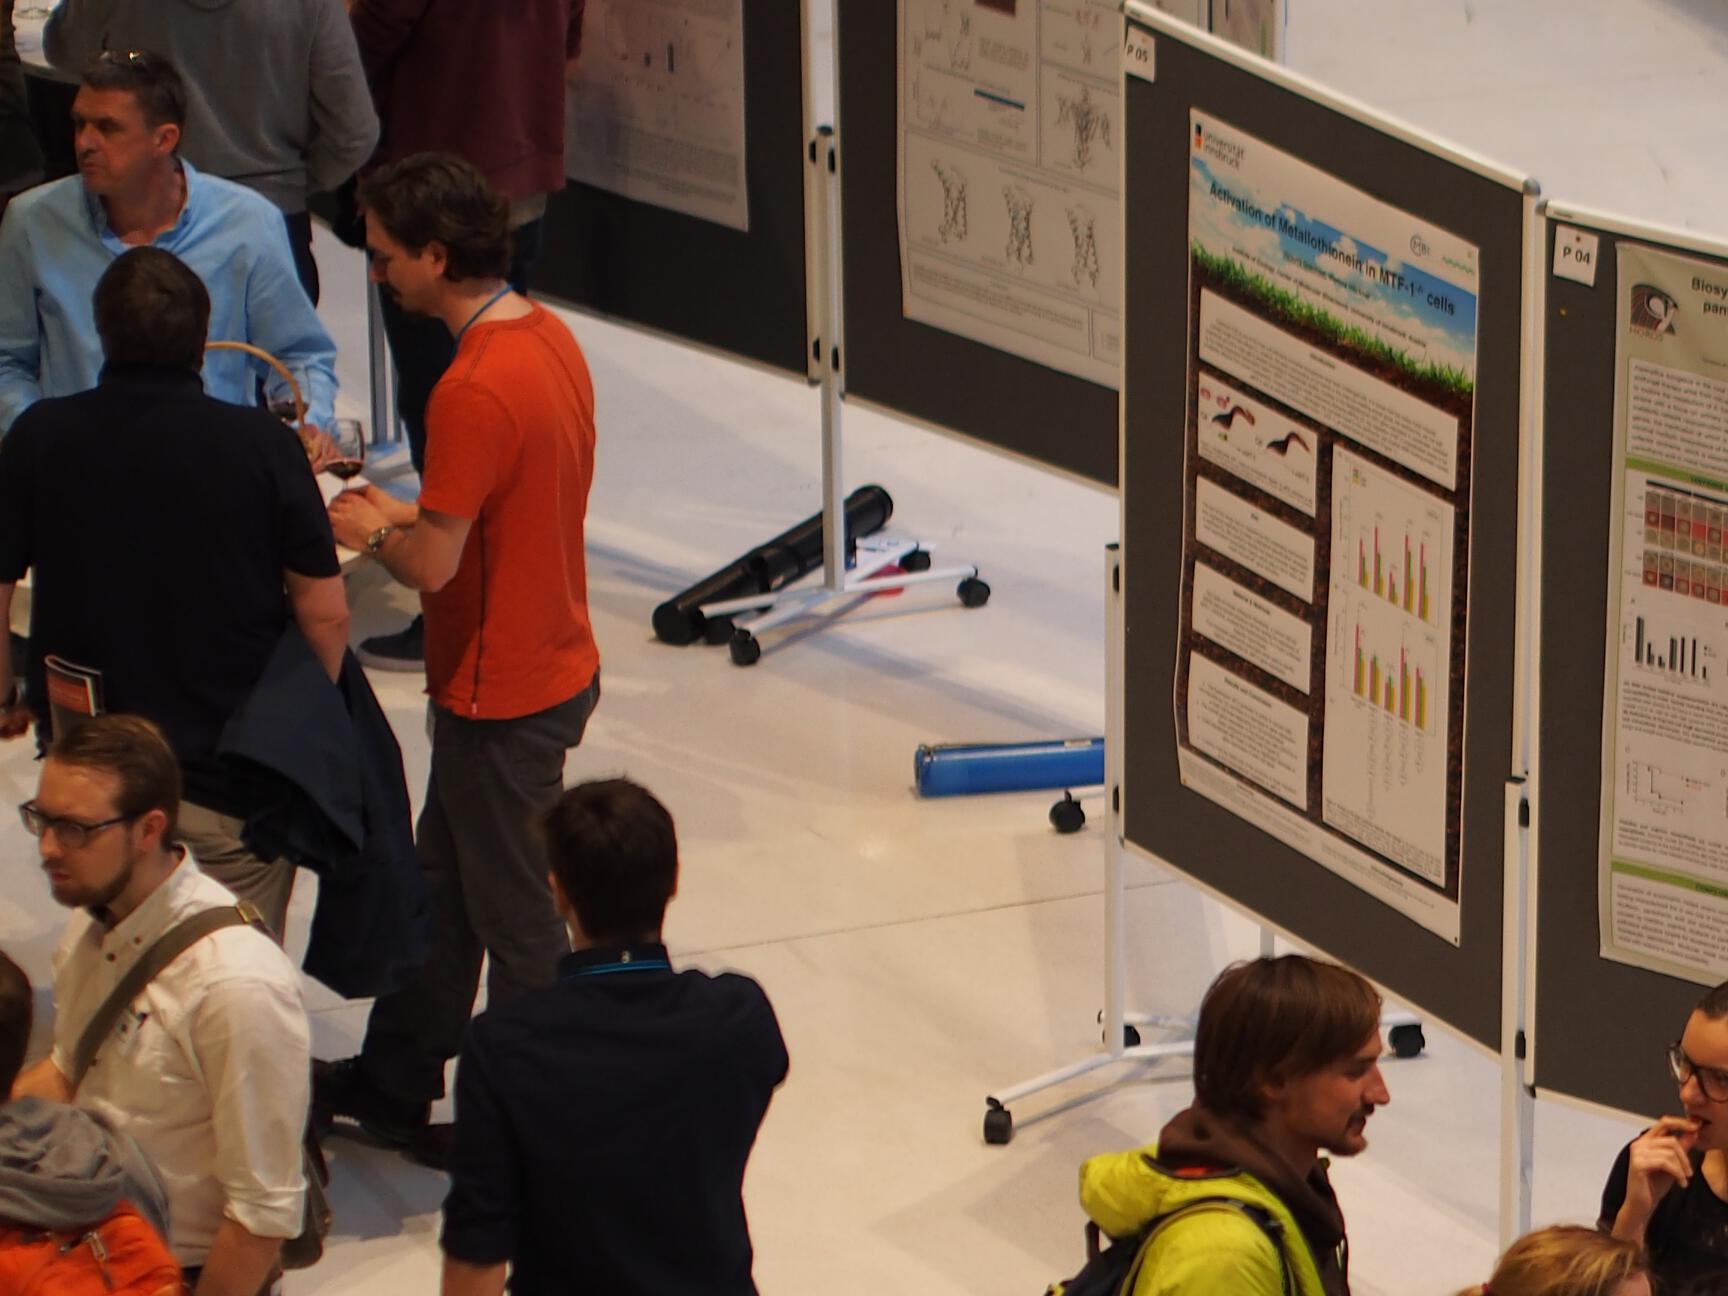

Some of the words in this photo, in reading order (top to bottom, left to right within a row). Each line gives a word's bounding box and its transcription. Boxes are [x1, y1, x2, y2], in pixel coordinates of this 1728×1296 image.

[1127, 44, 1134, 56] P
[1209, 179, 1262, 222] Activation
[1264, 213, 1276, 230] of
[1278, 217, 1362, 274] Metallothionein
[1365, 259, 1376, 280] in
[1426, 292, 1456, 317] cells
[1562, 245, 1571, 258] P
[1575, 250, 1591, 265] 04
